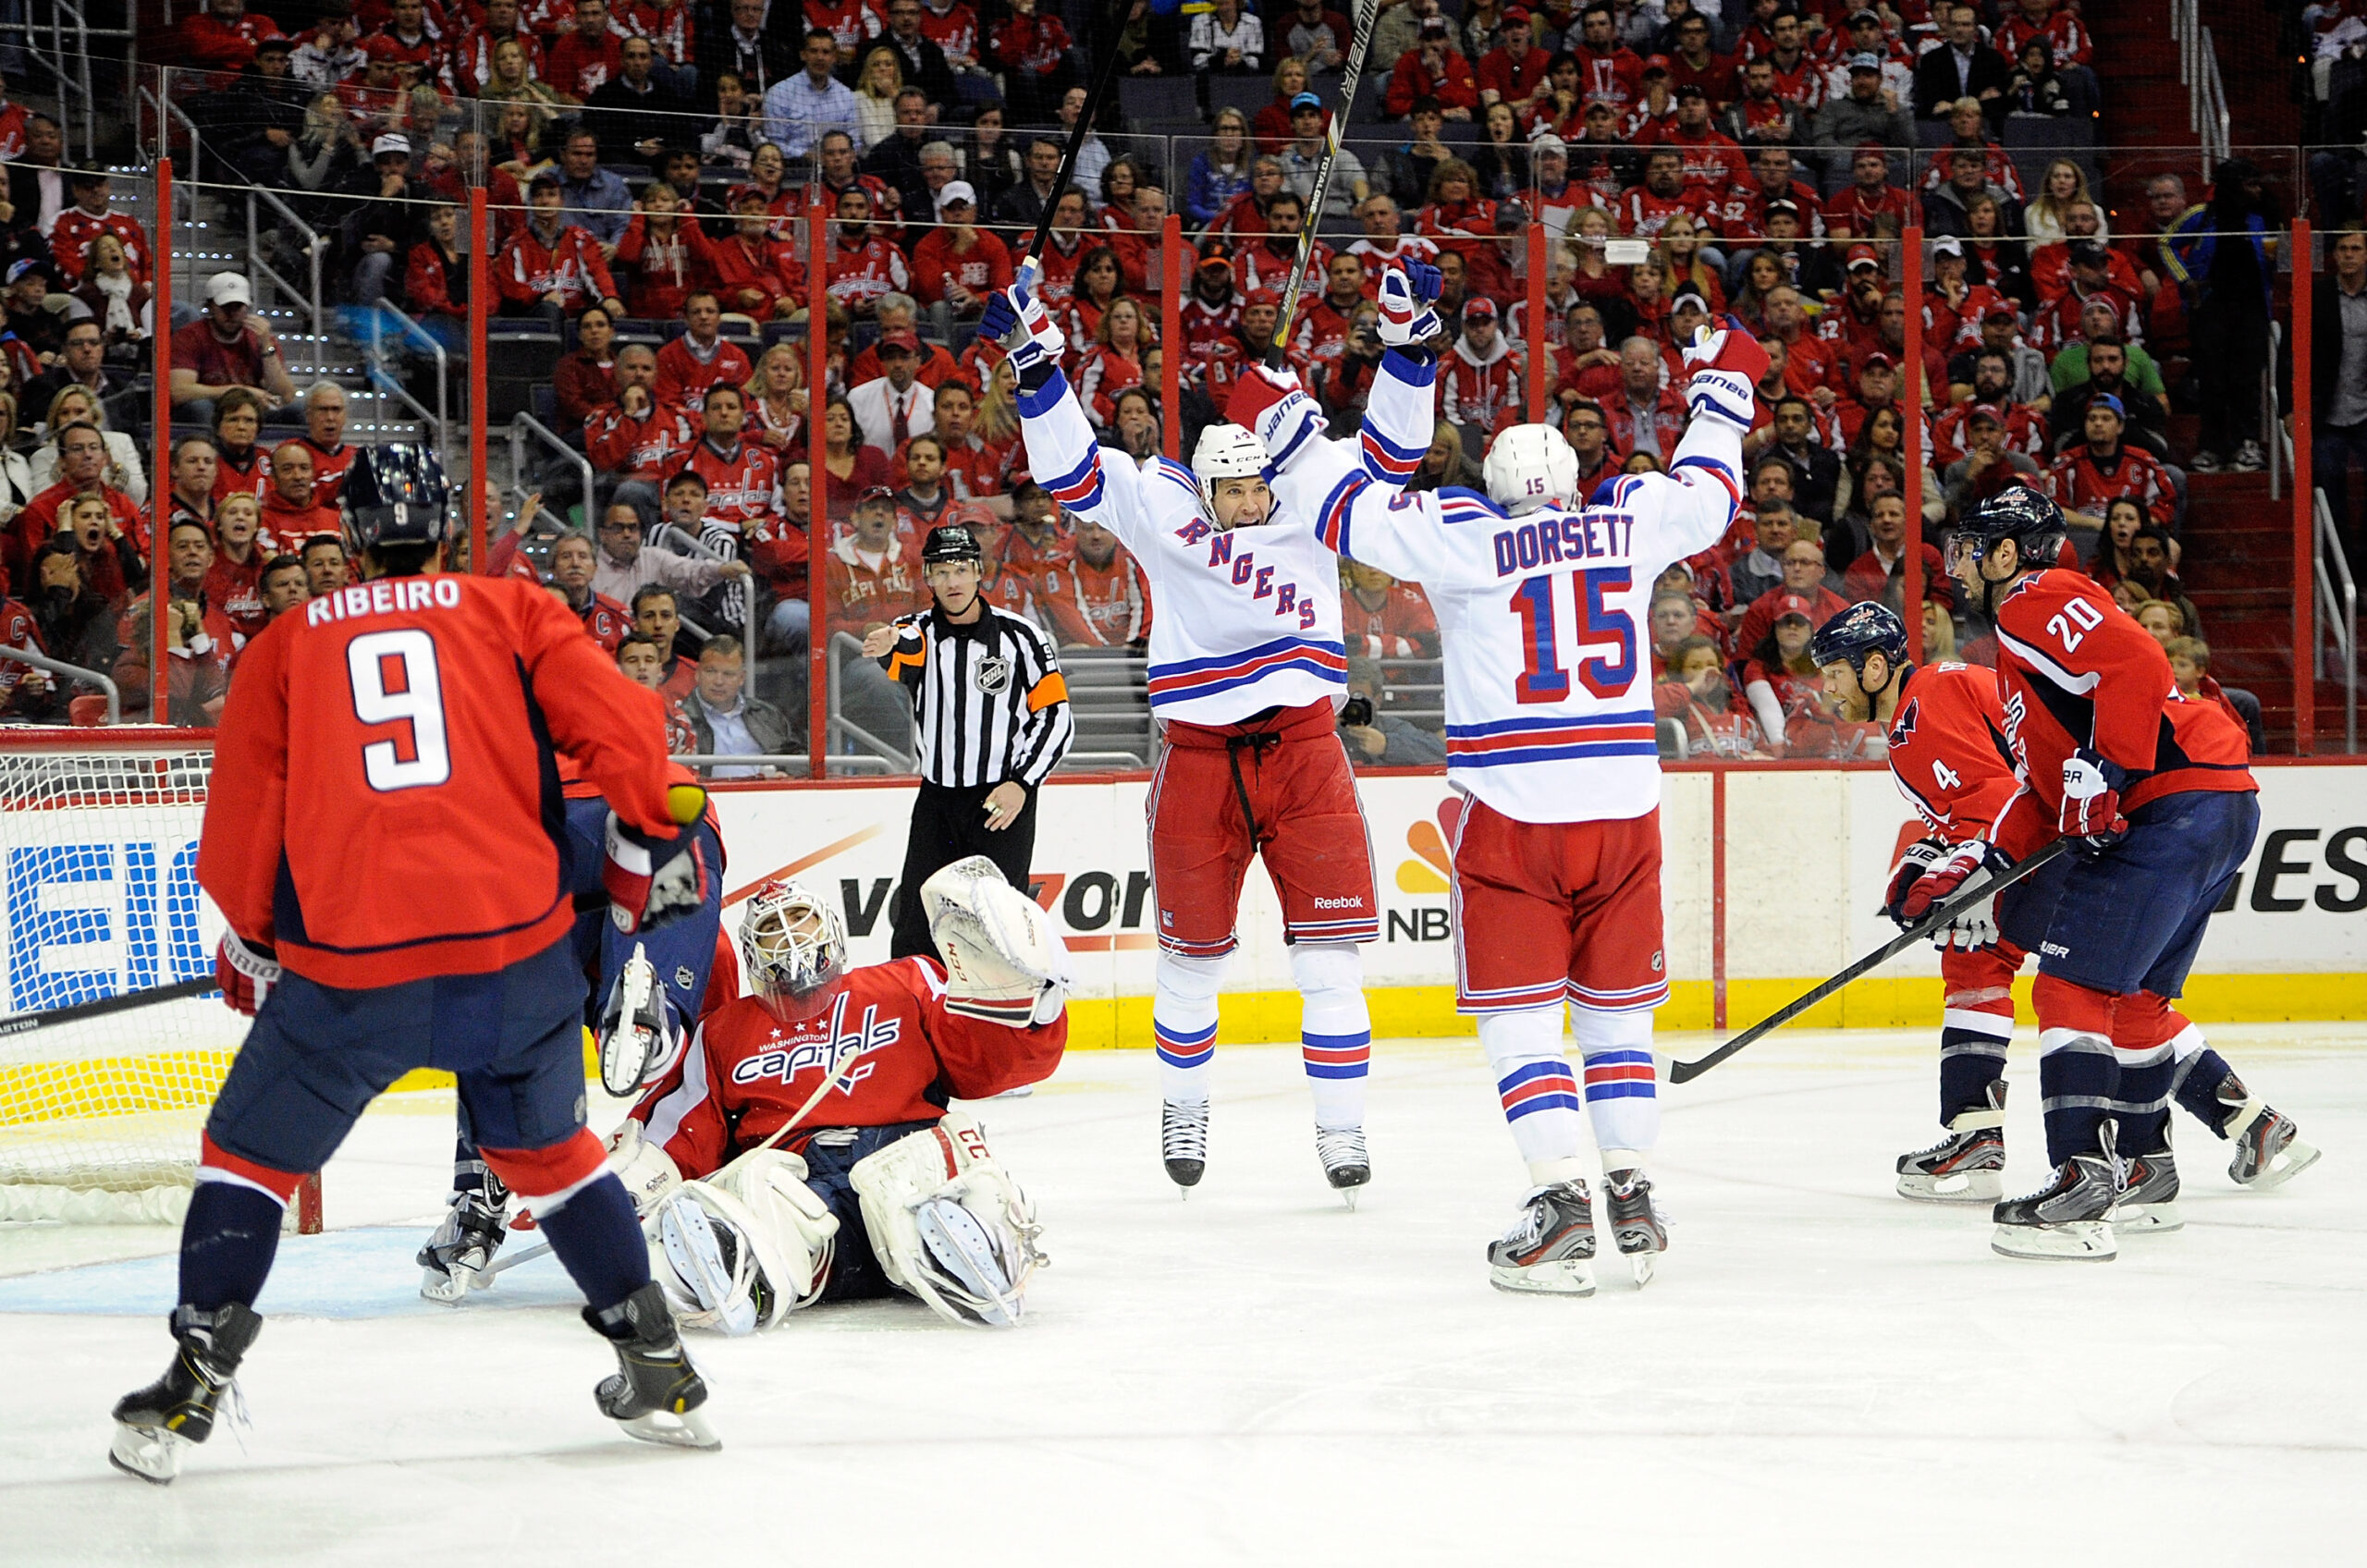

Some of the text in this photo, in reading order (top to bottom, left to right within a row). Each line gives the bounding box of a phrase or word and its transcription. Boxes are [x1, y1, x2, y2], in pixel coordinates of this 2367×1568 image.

[1526, 477, 1545, 495] 15
[394, 501, 408, 526] 9
[1493, 513, 1634, 578] DORSETT
[1174, 517, 1316, 630] RNGERS
[307, 578, 460, 627] RIBEIRO
[595, 611, 612, 636] C
[1510, 565, 1637, 704] 15
[2045, 596, 2105, 655] 20
[346, 629, 452, 792] 9
[1932, 758, 1962, 791] 4
[1314, 895, 1364, 910] Reebok
[758, 1032, 829, 1053] WASHINGTON
